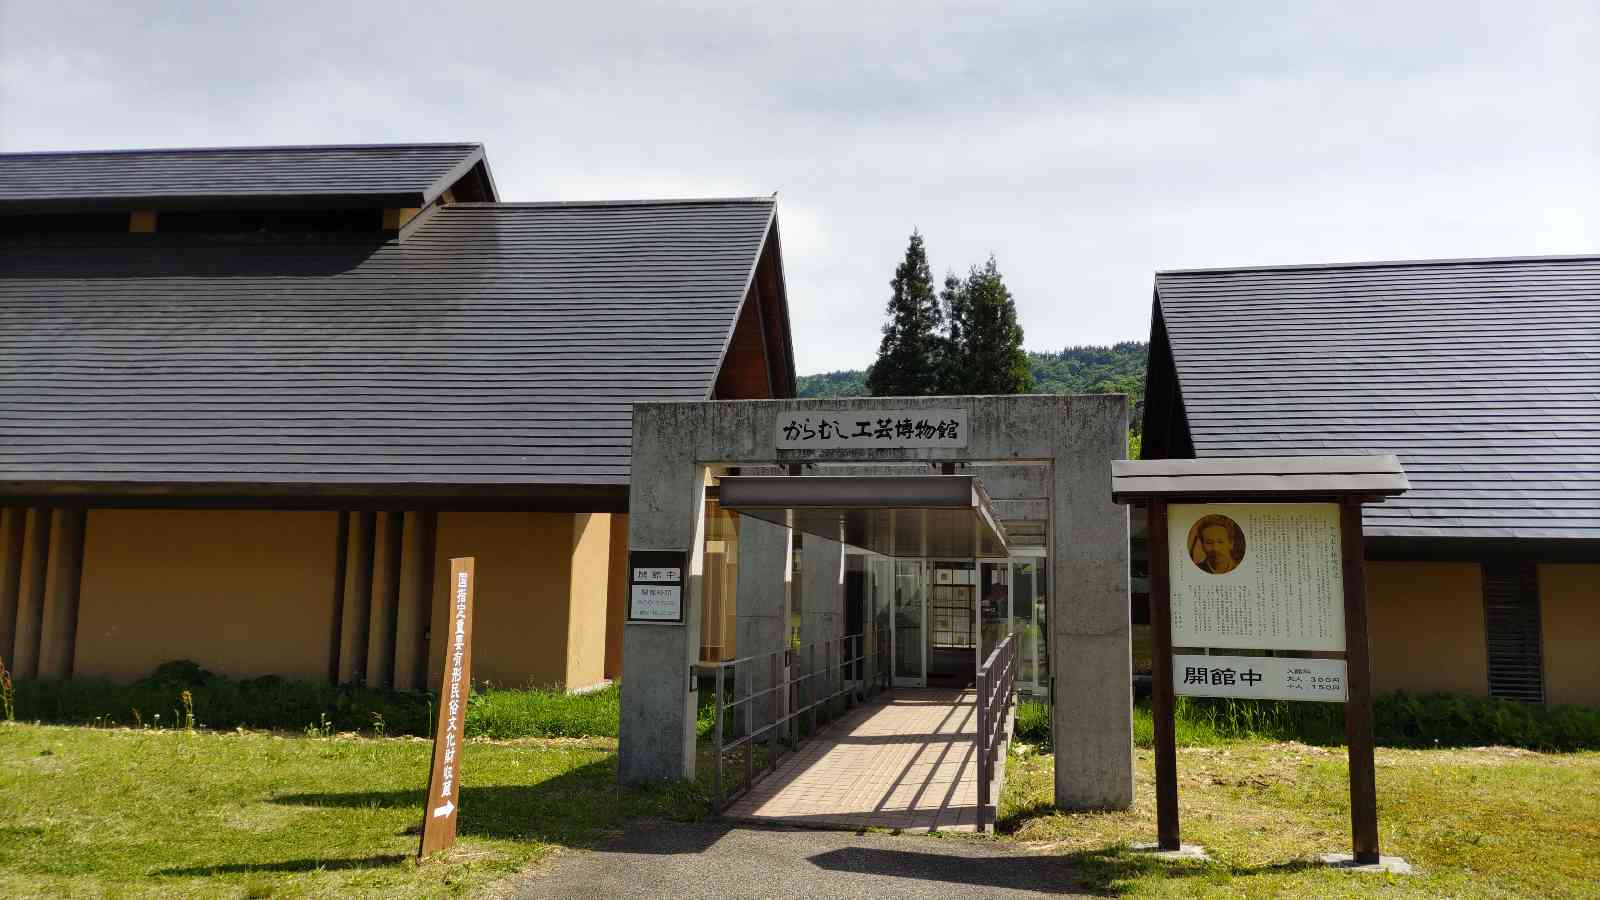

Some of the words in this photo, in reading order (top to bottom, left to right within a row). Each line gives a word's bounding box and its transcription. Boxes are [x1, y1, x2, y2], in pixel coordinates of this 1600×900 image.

[783, 417, 960, 441] からむし工芸博物館
[1183, 666, 1263, 687] 開館中
